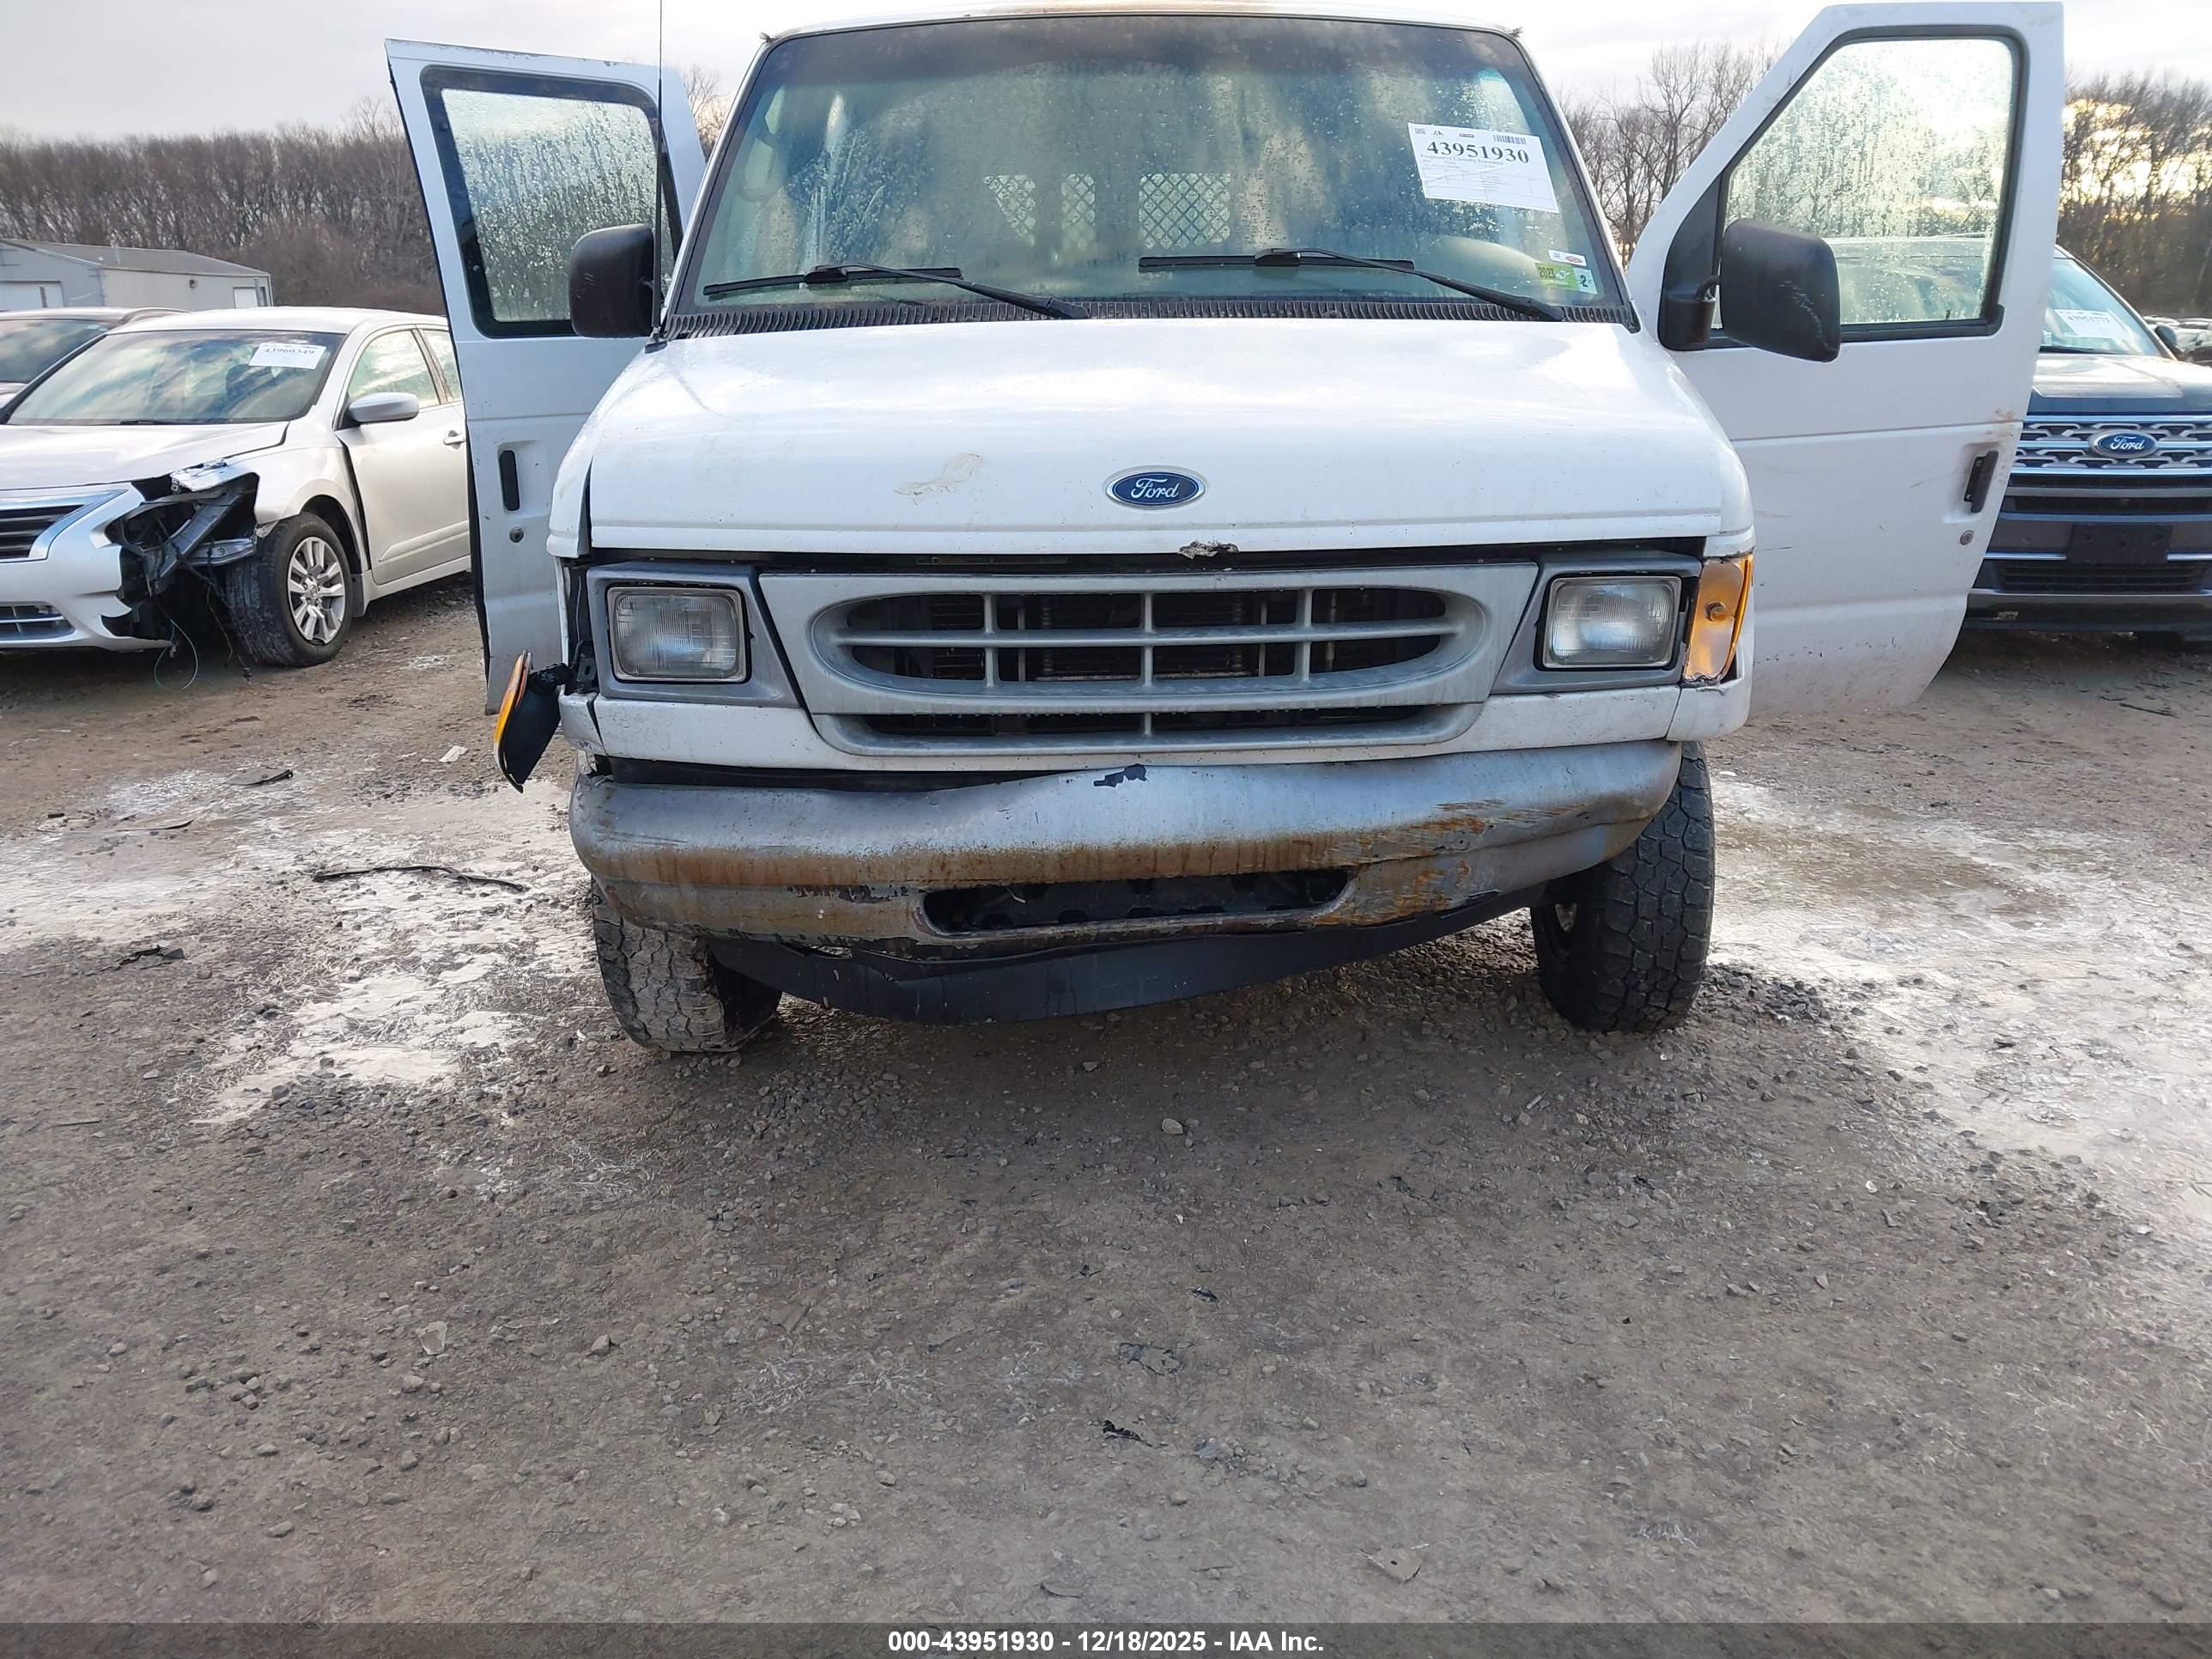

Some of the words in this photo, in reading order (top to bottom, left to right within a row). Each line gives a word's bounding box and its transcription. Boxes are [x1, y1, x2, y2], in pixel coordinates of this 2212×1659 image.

[1427, 141, 1529, 164] 43951930
[1580, 274, 1589, 288] 2
[2110, 435, 2145, 450] Ford
[1130, 477, 1180, 499] Ford
